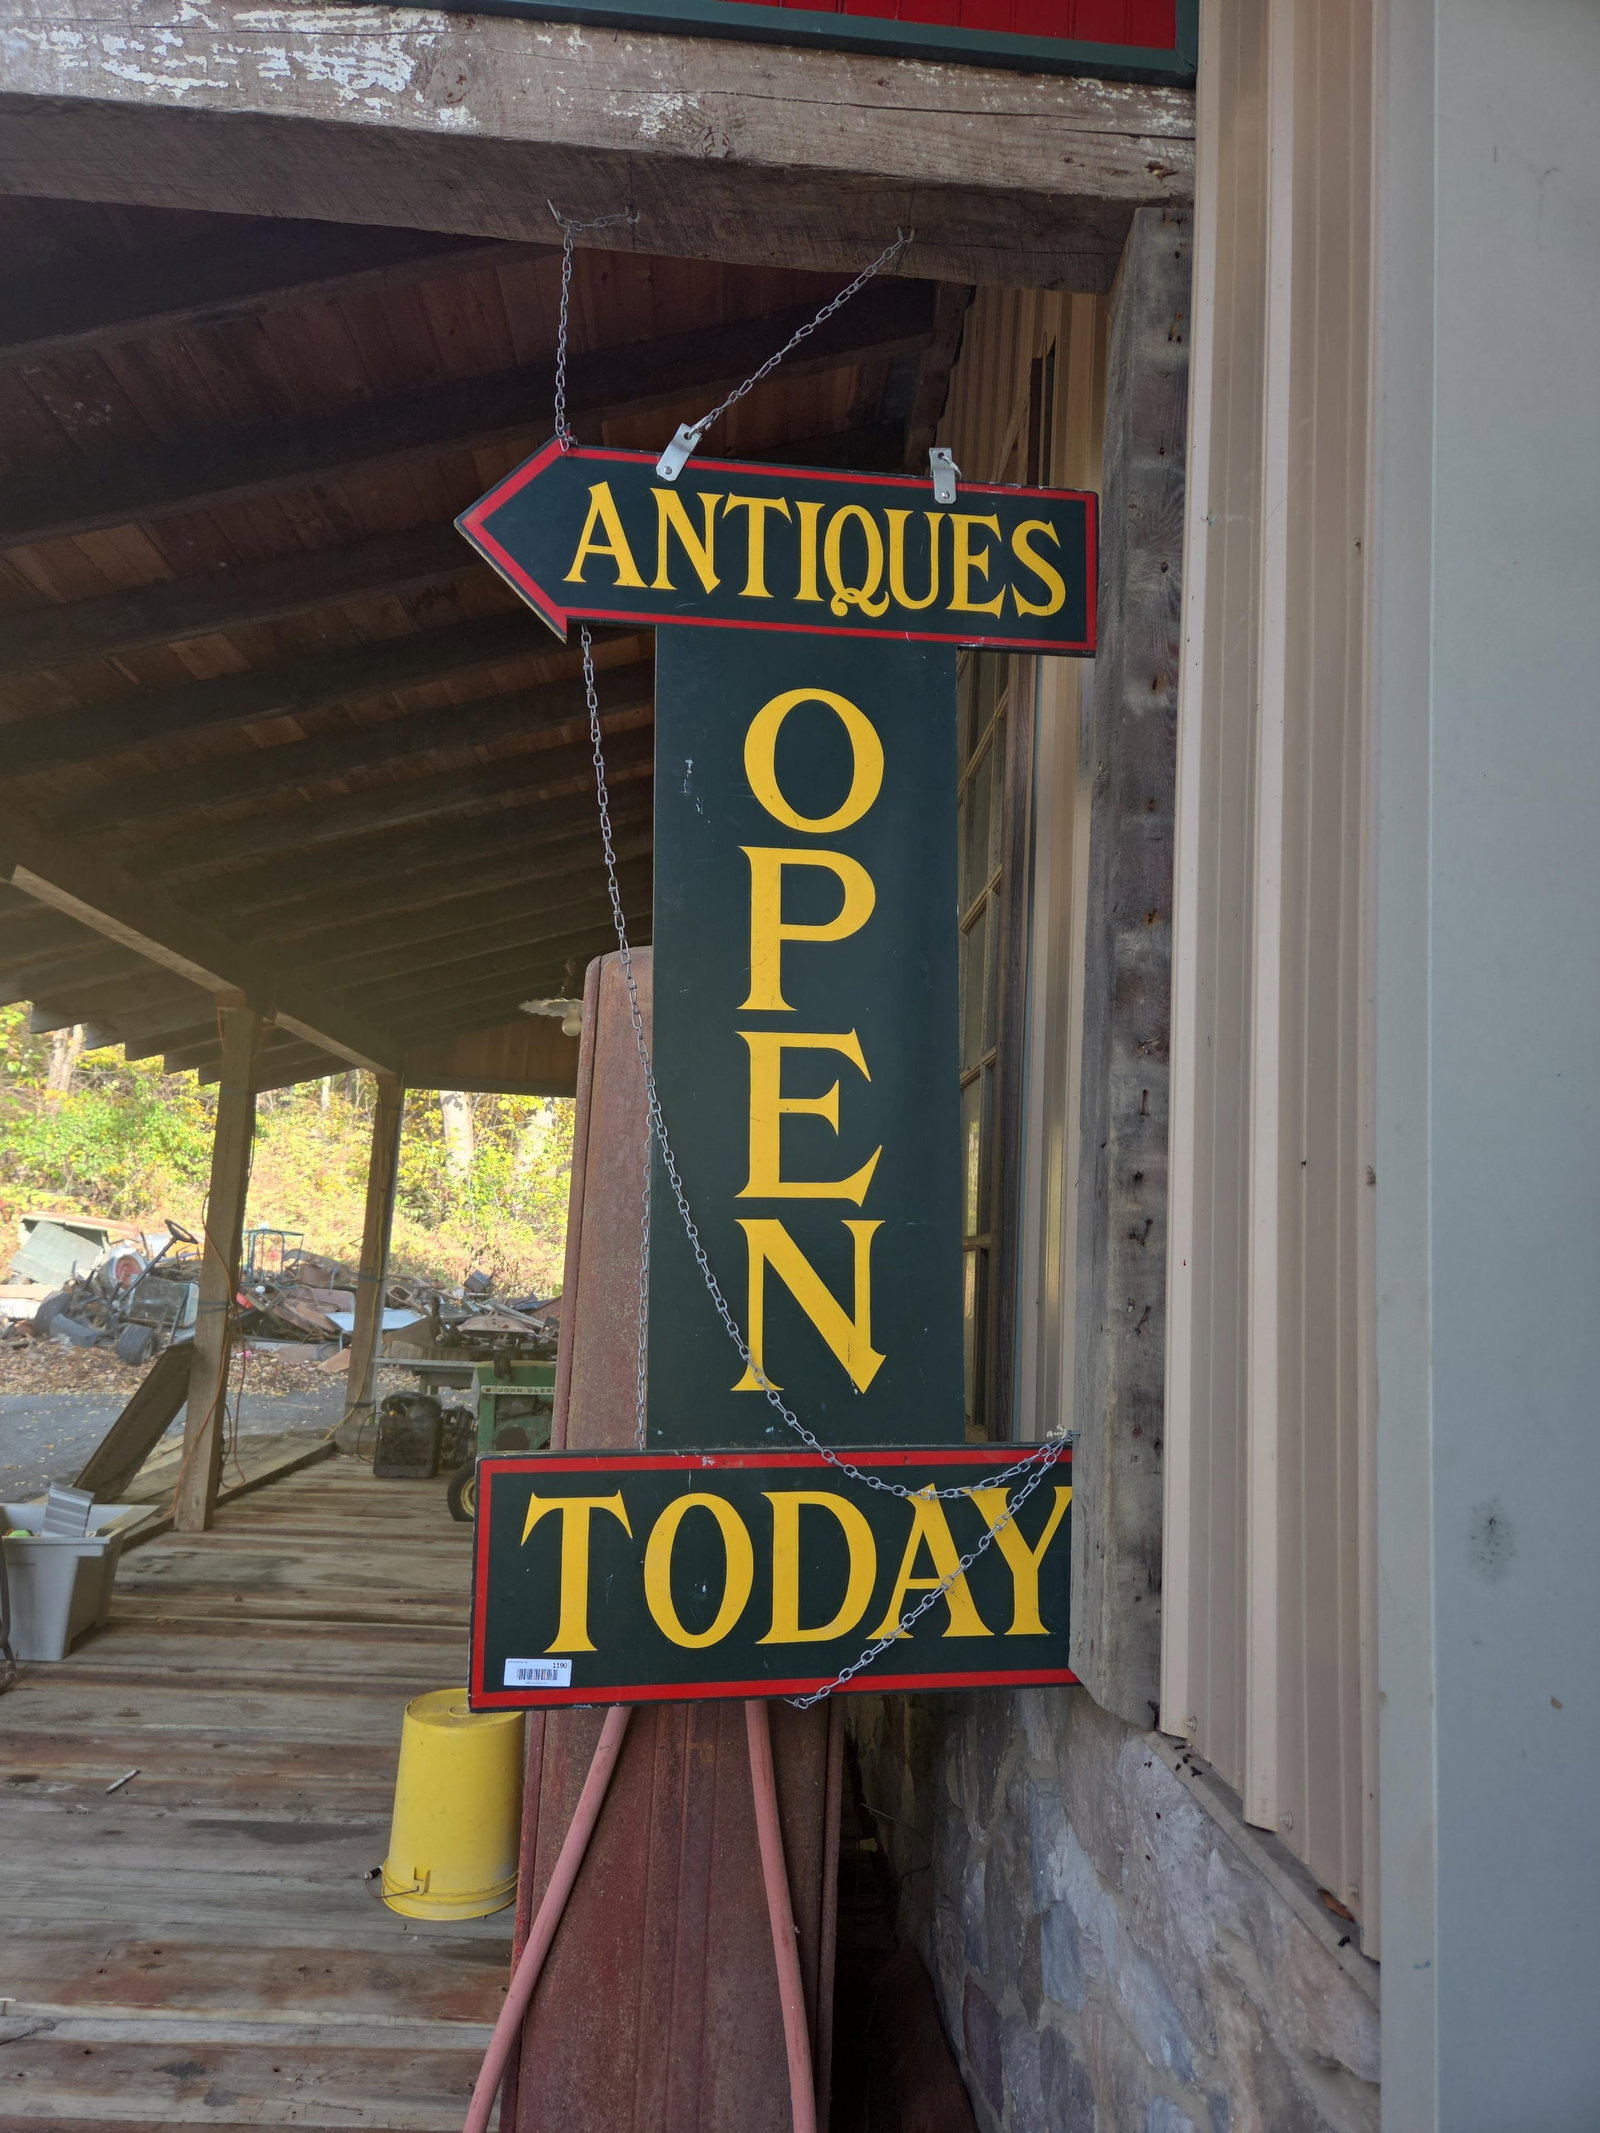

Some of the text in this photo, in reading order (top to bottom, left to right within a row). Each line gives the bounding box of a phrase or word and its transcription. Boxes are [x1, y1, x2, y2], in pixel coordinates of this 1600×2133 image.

[563, 480, 1067, 618] ANTIQUES
[731, 687, 887, 1394] OPEN
[520, 1483, 1073, 1654] TODAY
